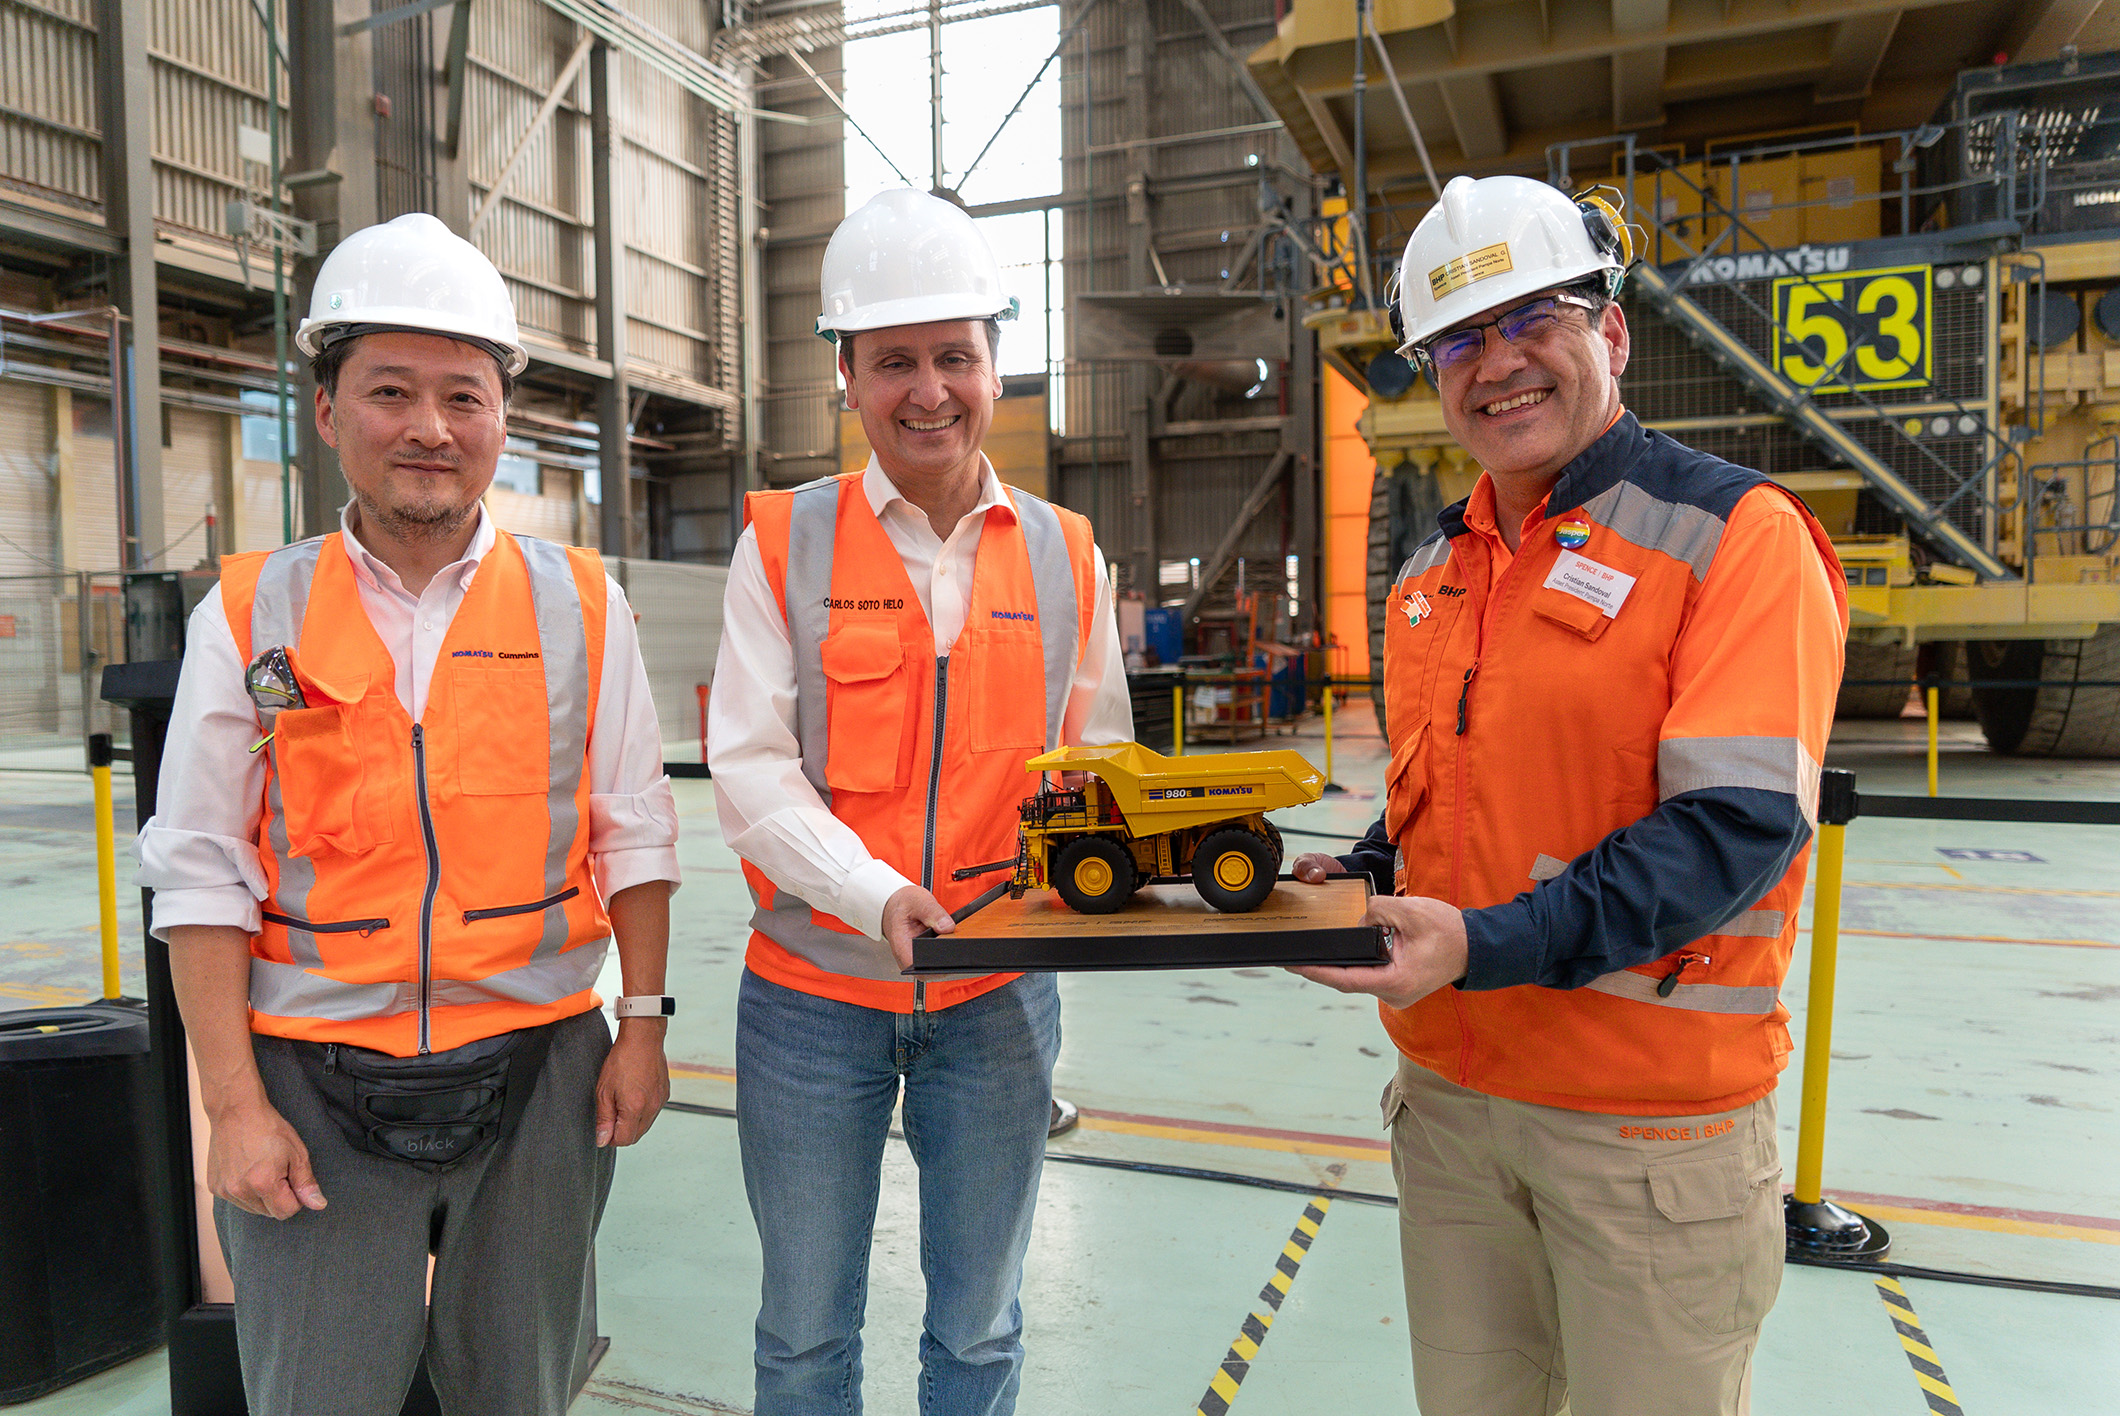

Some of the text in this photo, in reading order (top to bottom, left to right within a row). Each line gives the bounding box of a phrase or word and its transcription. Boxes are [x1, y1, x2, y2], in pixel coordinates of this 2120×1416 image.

[1469, 252, 1498, 265] SANDOVAL
[1690, 245, 1850, 284] KOMATSU
[1432, 273, 1445, 286] BHP
[1782, 275, 1922, 386] 53
[1559, 527, 1585, 537] Jasper
[1575, 561, 1598, 575] SPENCE
[1601, 572, 1614, 581] BHP
[1438, 585, 1467, 597] BHP
[1563, 572, 1611, 599] Cristian Sandoval
[1553, 577, 1614, 610] Asset President Pampa Norte
[823, 597, 903, 610] CARLOS SOTO HELO
[992, 611, 1034, 622] KOMATSU
[452, 650, 493, 658] KOMATSU
[1165, 786, 1253, 798] 980E KOMATSU
[1619, 1126, 1692, 1140] SPENCE
[1704, 1119, 1735, 1138] BHP
